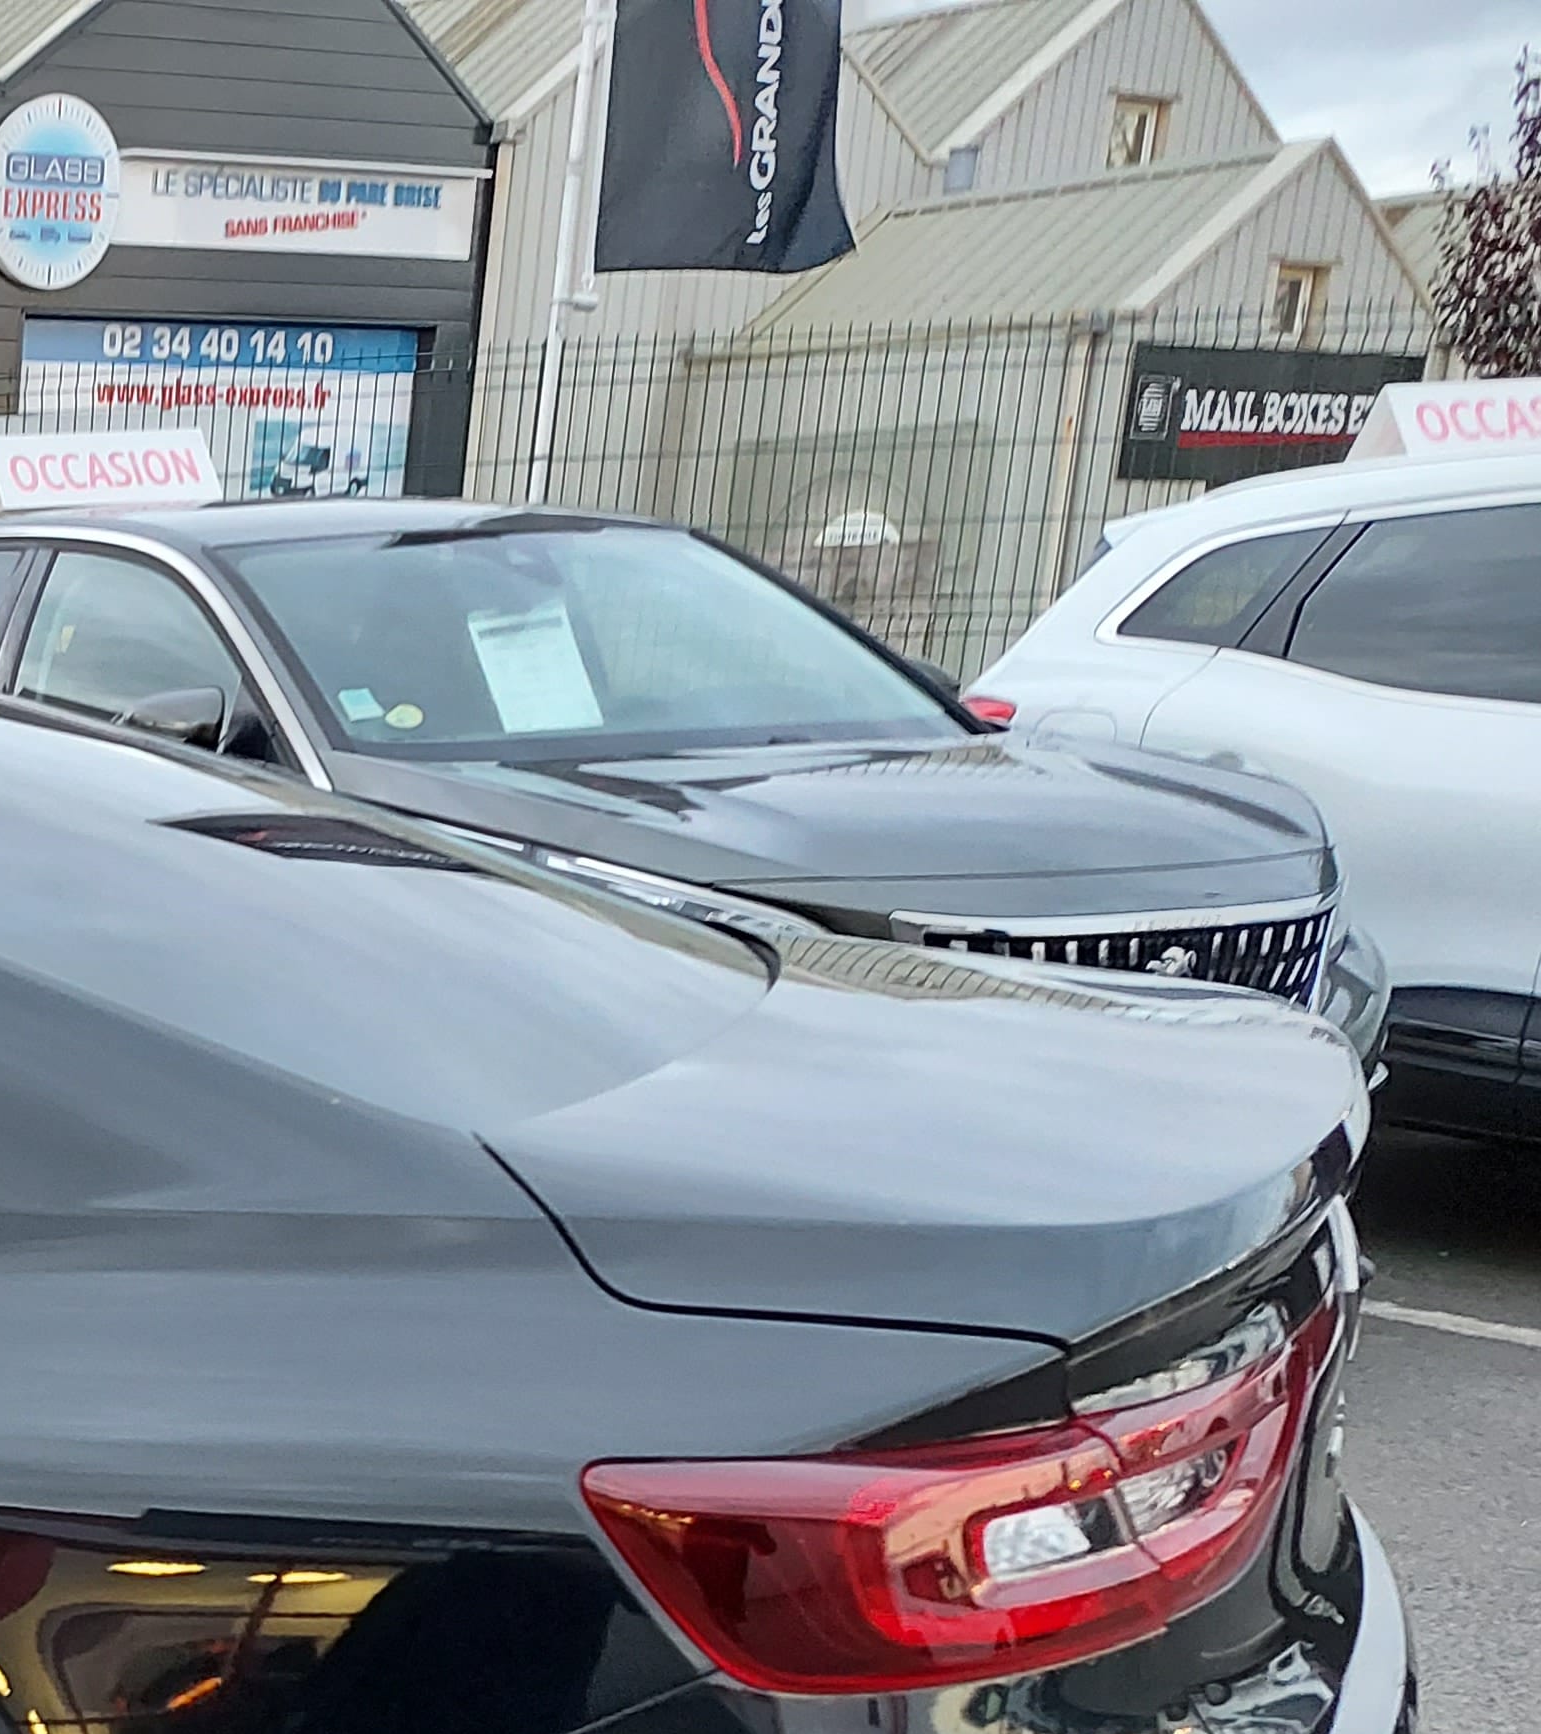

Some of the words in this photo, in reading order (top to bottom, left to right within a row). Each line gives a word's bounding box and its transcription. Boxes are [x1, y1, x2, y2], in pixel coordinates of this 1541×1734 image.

[749, 0, 783, 191] GRAND
[8, 153, 103, 184] GLASS
[152, 168, 178, 197] LE
[184, 164, 313, 204] SPÉCIALISTE
[318, 179, 343, 204] DU
[3, 188, 103, 223] EXPRESS
[225, 216, 269, 238] SANS
[103, 324, 142, 358] 02
[152, 326, 191, 360] 34
[200, 327, 240, 361] 40
[249, 329, 287, 364] 14
[296, 331, 335, 364] 10
[96, 377, 332, 411] www.glass-express.fr
[1180, 388, 1259, 433] MAIL
[1259, 391, 1350, 436] BOXES
[1346, 394, 1376, 435] E
[8, 448, 201, 493] OCCASION
